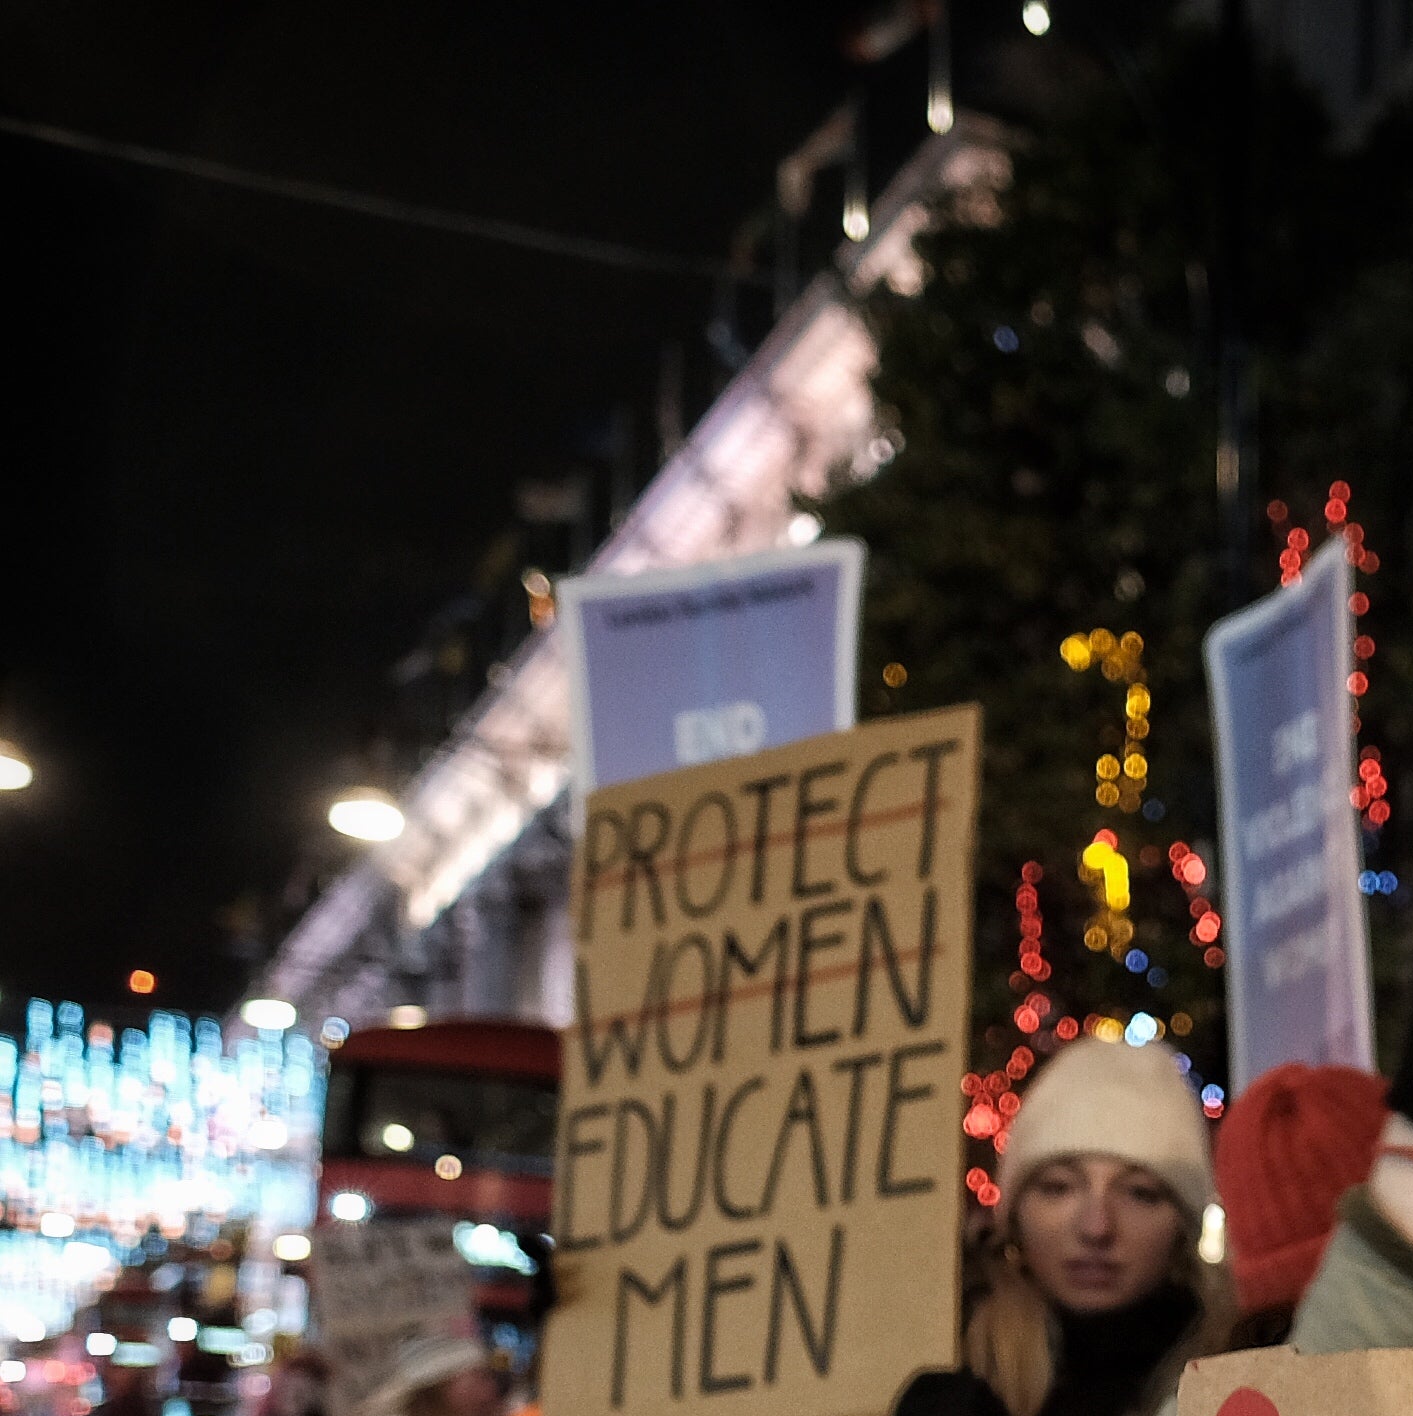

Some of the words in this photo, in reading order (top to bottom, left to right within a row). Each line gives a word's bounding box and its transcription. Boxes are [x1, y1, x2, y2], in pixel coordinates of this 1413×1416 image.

[577, 739, 960, 941] PROTECT
[574, 888, 940, 1088] WOMEN
[561, 1041, 946, 1251] EDUCATE
[608, 1223, 846, 1408] MEN
